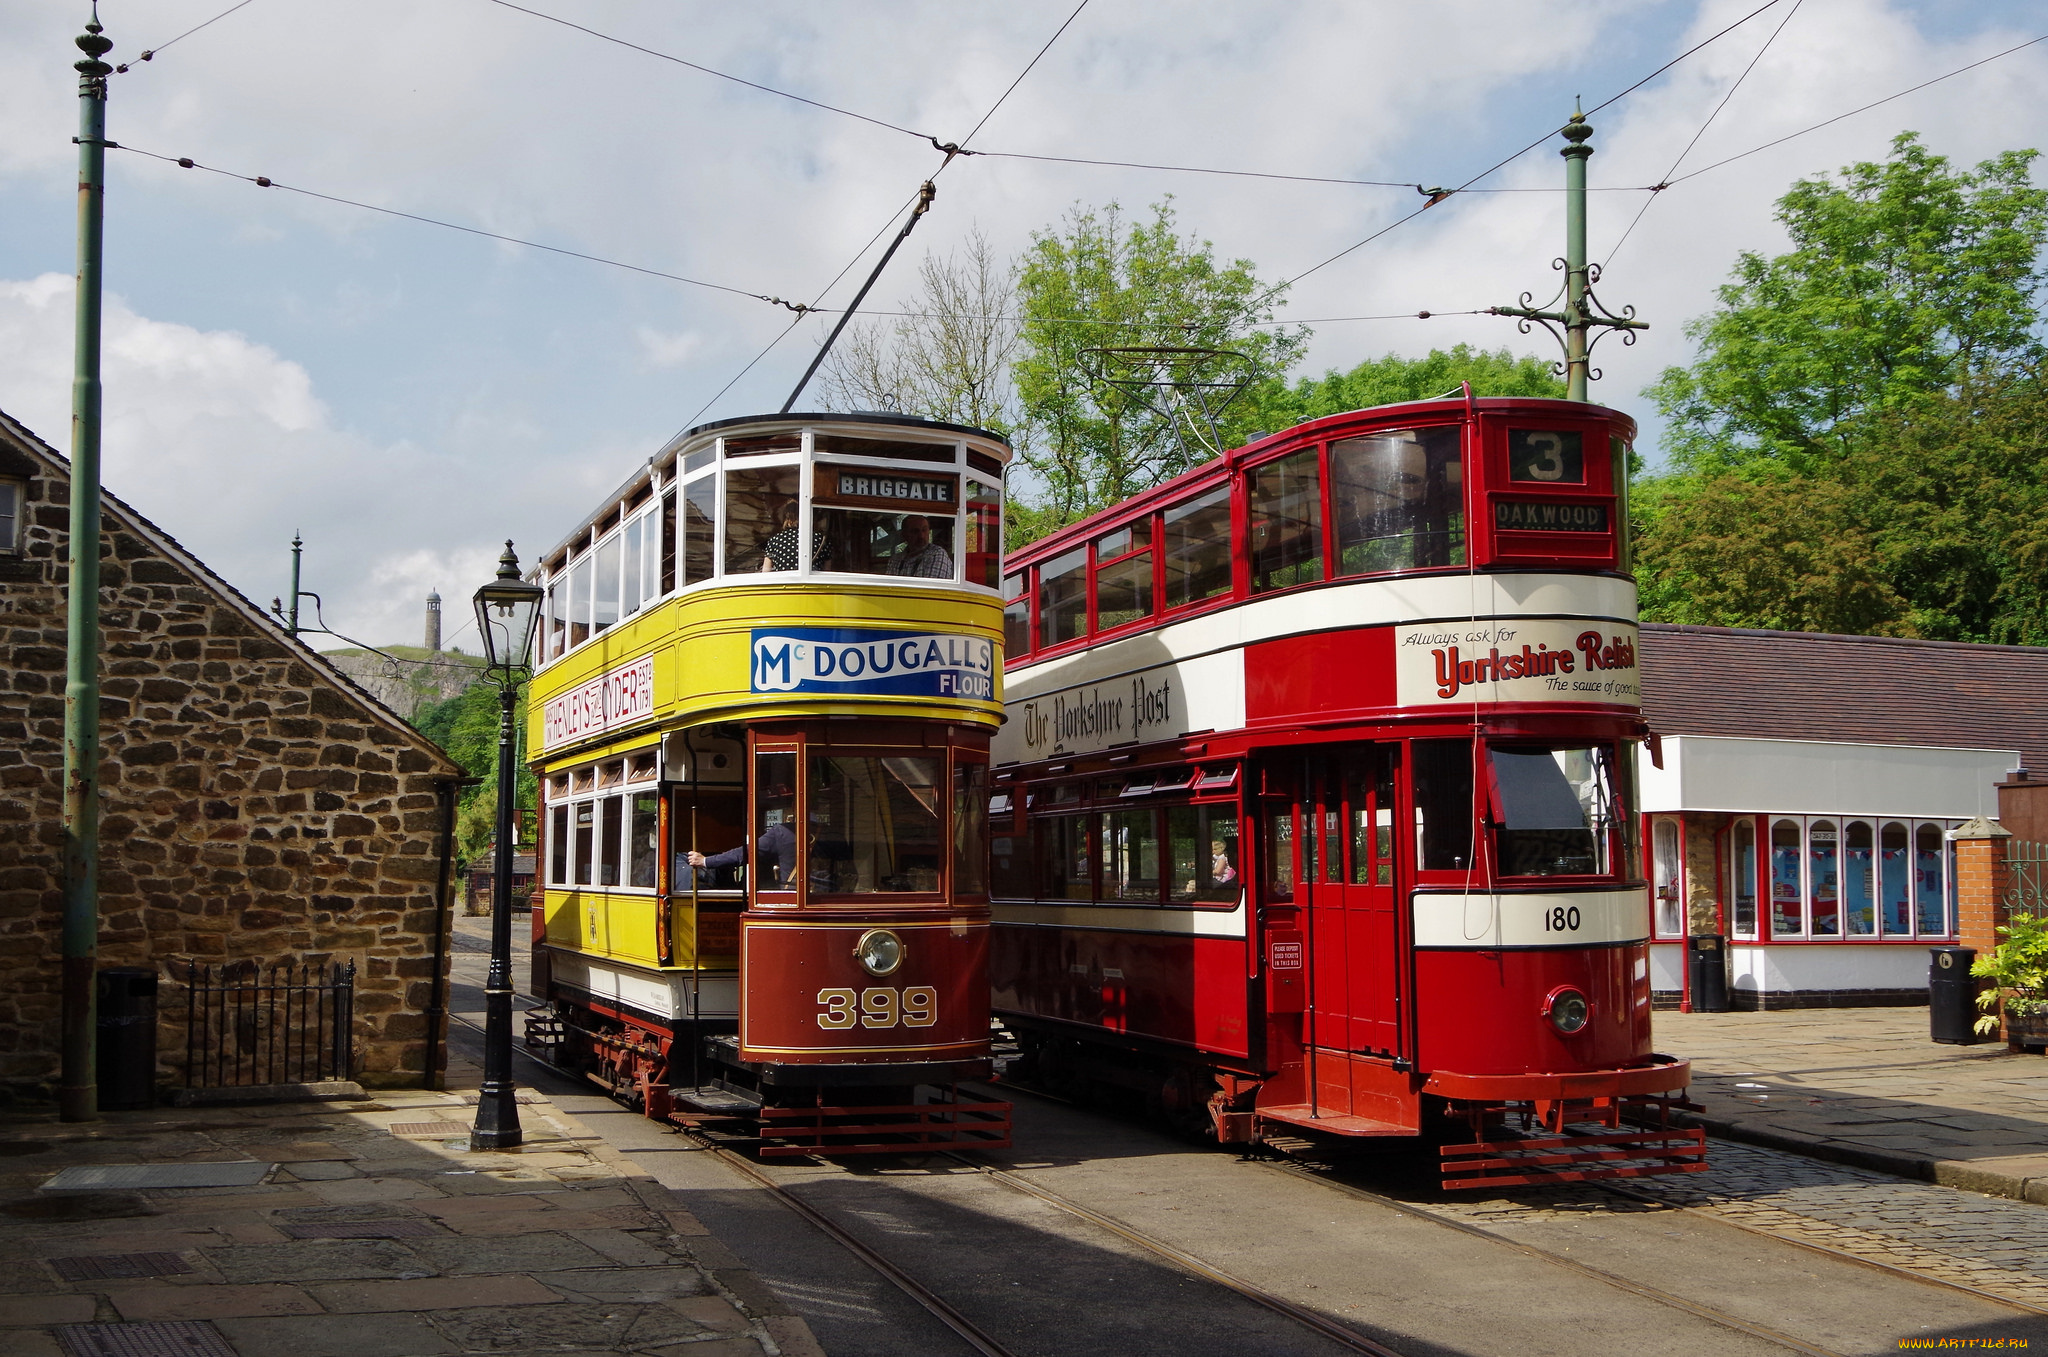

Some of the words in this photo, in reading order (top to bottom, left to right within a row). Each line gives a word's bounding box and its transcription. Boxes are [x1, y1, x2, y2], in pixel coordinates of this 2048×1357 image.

[1526, 431, 1563, 481] 3
[840, 474, 949, 502] BRIGGATE
[1497, 503, 1599, 525] OAKWOOD
[1402, 633, 1460, 647] Always
[1465, 630, 1490, 643] ask
[1494, 627, 1517, 644] for
[1431, 642, 1575, 699] Yorkshire
[1575, 630, 1635, 672] Relish
[601, 669, 638, 723] CYDER
[639, 687, 652, 710] 1791
[939, 674, 991, 697] FLOUR
[1545, 677, 1569, 691] The
[1572, 681, 1602, 692] sauce
[1603, 680, 1615, 696] of
[1024, 700, 1049, 755] The
[1053, 687, 1123, 754] Yorkshire
[1131, 676, 1170, 739] Post
[1545, 906, 1581, 932] 180
[817, 986, 938, 1030] 399
